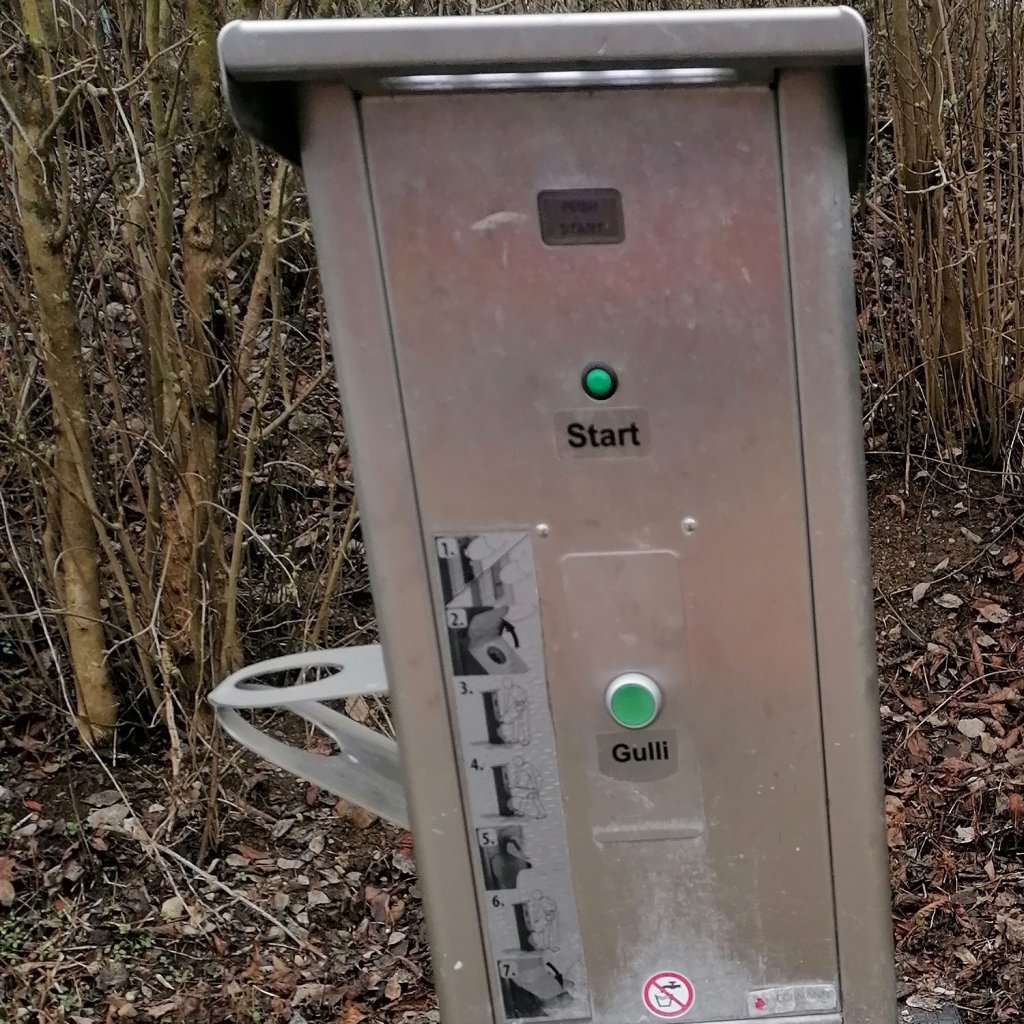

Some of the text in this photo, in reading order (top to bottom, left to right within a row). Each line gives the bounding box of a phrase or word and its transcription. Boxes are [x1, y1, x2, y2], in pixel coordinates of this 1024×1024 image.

[567, 422, 641, 448] Start
[442, 542, 455, 556] 1.
[450, 612, 465, 626] 2.
[459, 681, 474, 695] 3.
[612, 740, 669, 763] Gulli
[470, 758, 484, 771] 4.
[482, 832, 495, 846] 5.
[492, 895, 505, 908] 6.
[503, 965, 516, 977] 7.
